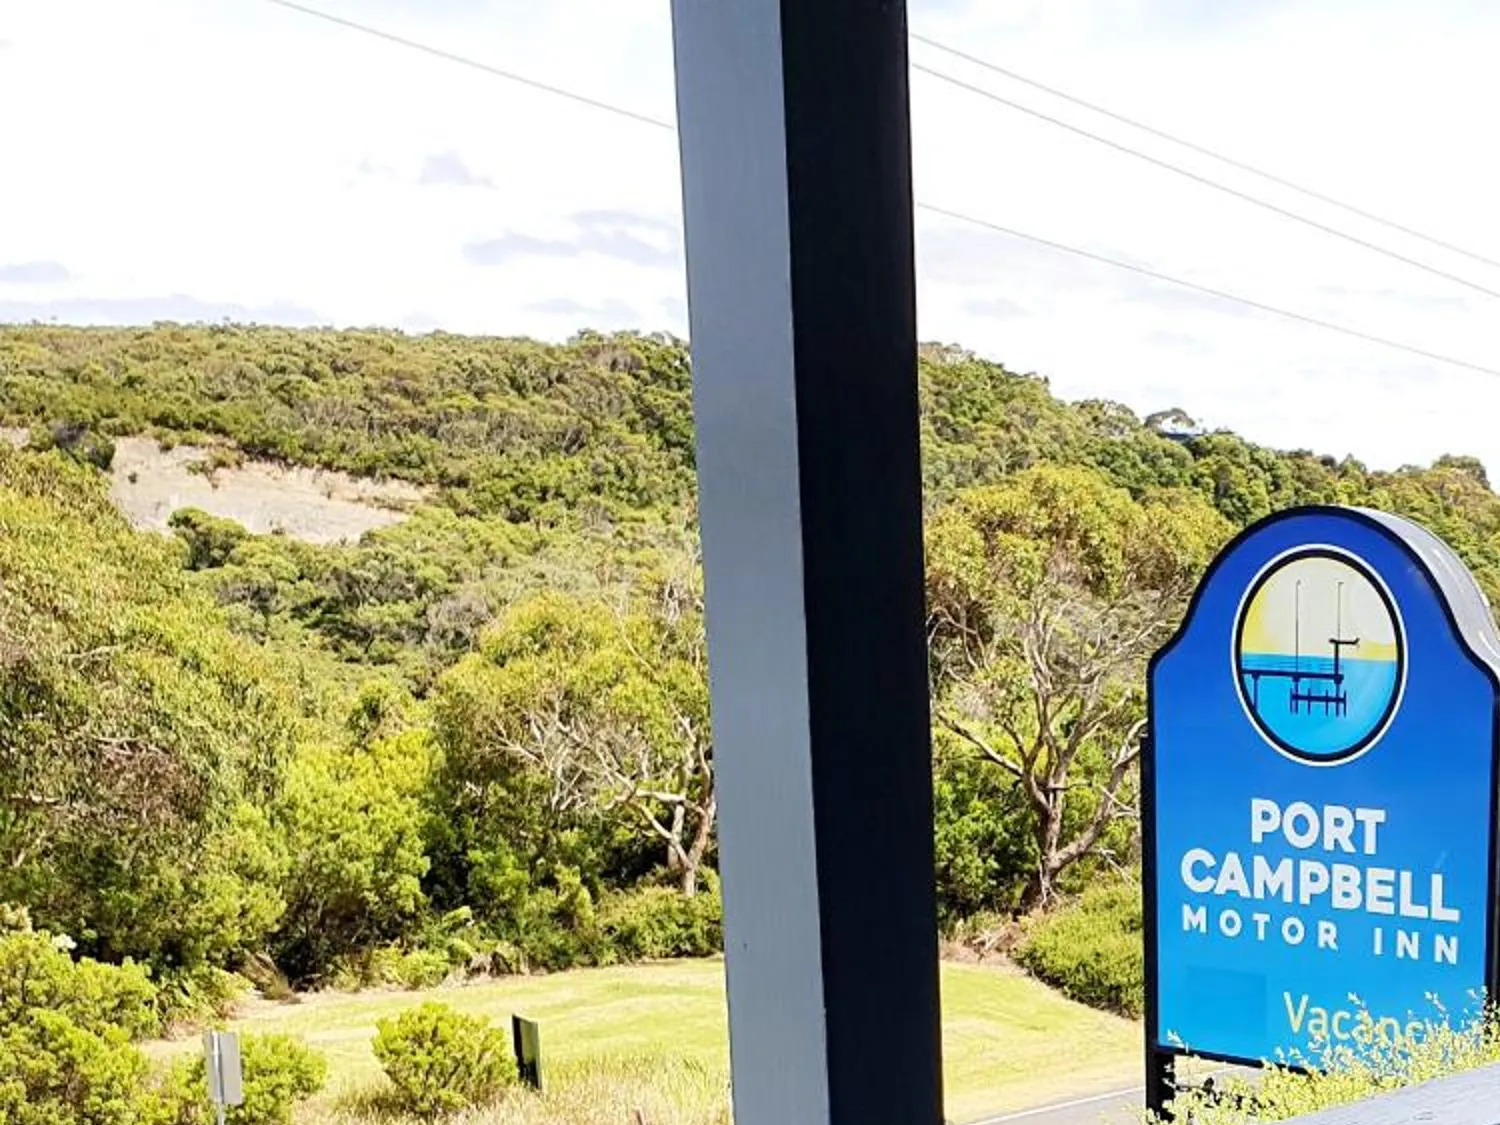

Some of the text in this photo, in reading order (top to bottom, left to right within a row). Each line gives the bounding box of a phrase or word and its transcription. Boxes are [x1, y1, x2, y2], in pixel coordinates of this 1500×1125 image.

[1250, 798, 1387, 855] PORT
[1180, 848, 1461, 923] CAMPBELL
[1182, 904, 1458, 965] MOTOR INN
[1283, 991, 1446, 1052] Vacanc
